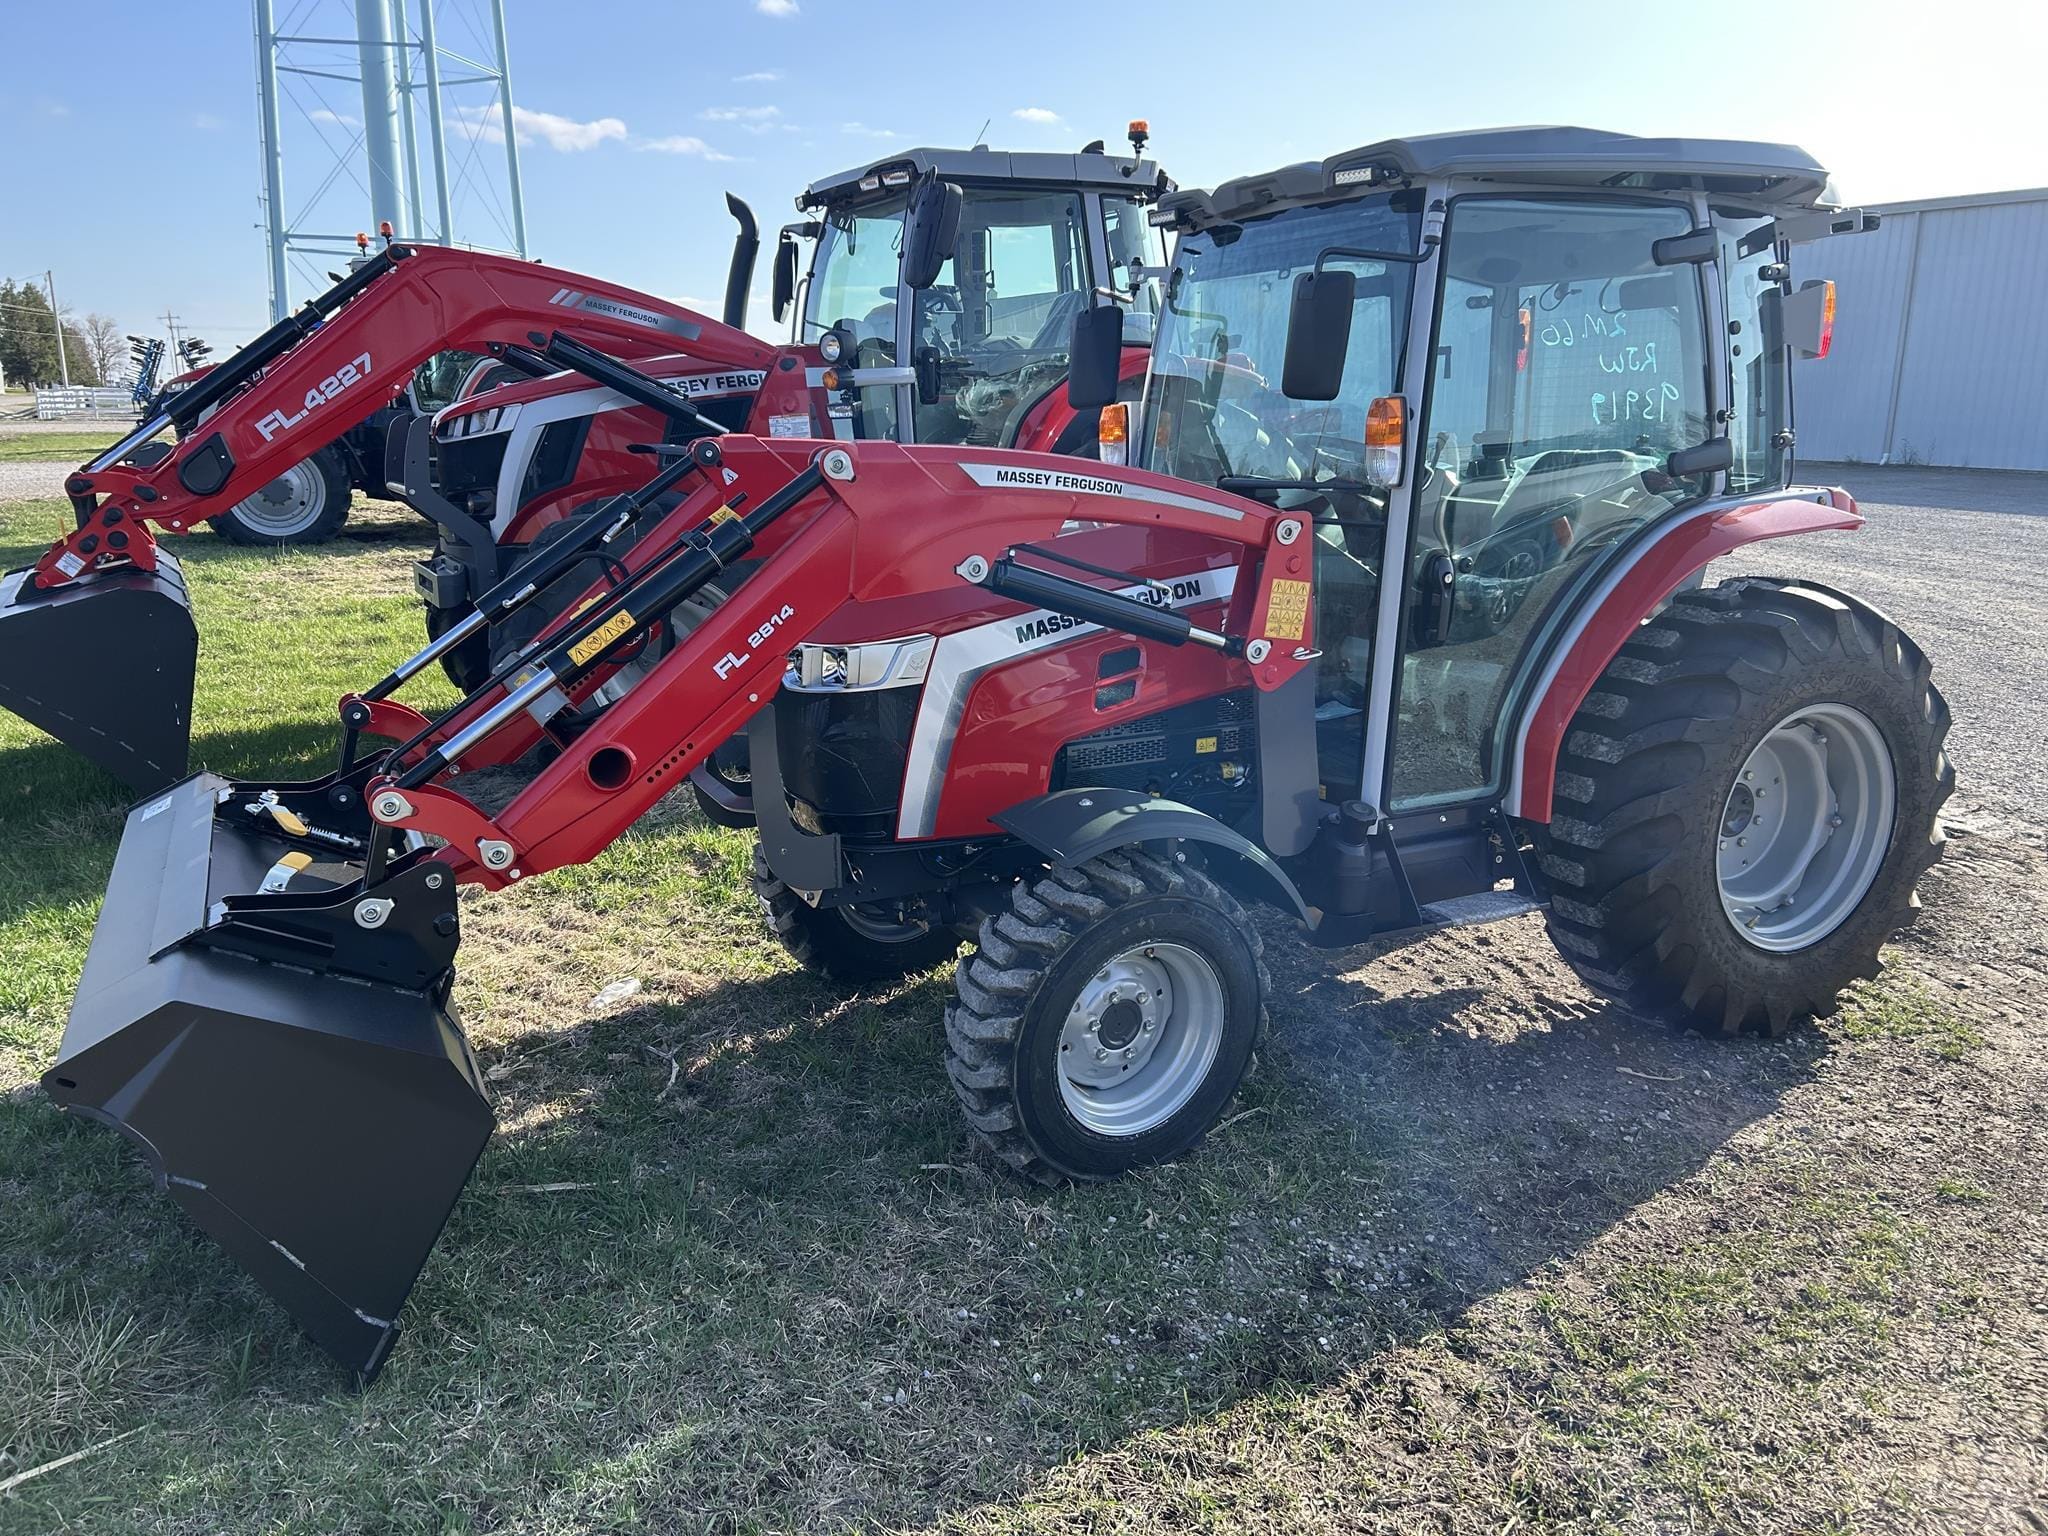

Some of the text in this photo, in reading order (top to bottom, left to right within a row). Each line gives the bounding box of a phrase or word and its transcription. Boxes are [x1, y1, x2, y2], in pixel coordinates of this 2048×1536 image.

[585, 300, 659, 325] MASSEY FERGUSON
[996, 470, 1123, 494] MASSEY FERGUSON
[712, 604, 795, 681] FL 2814
